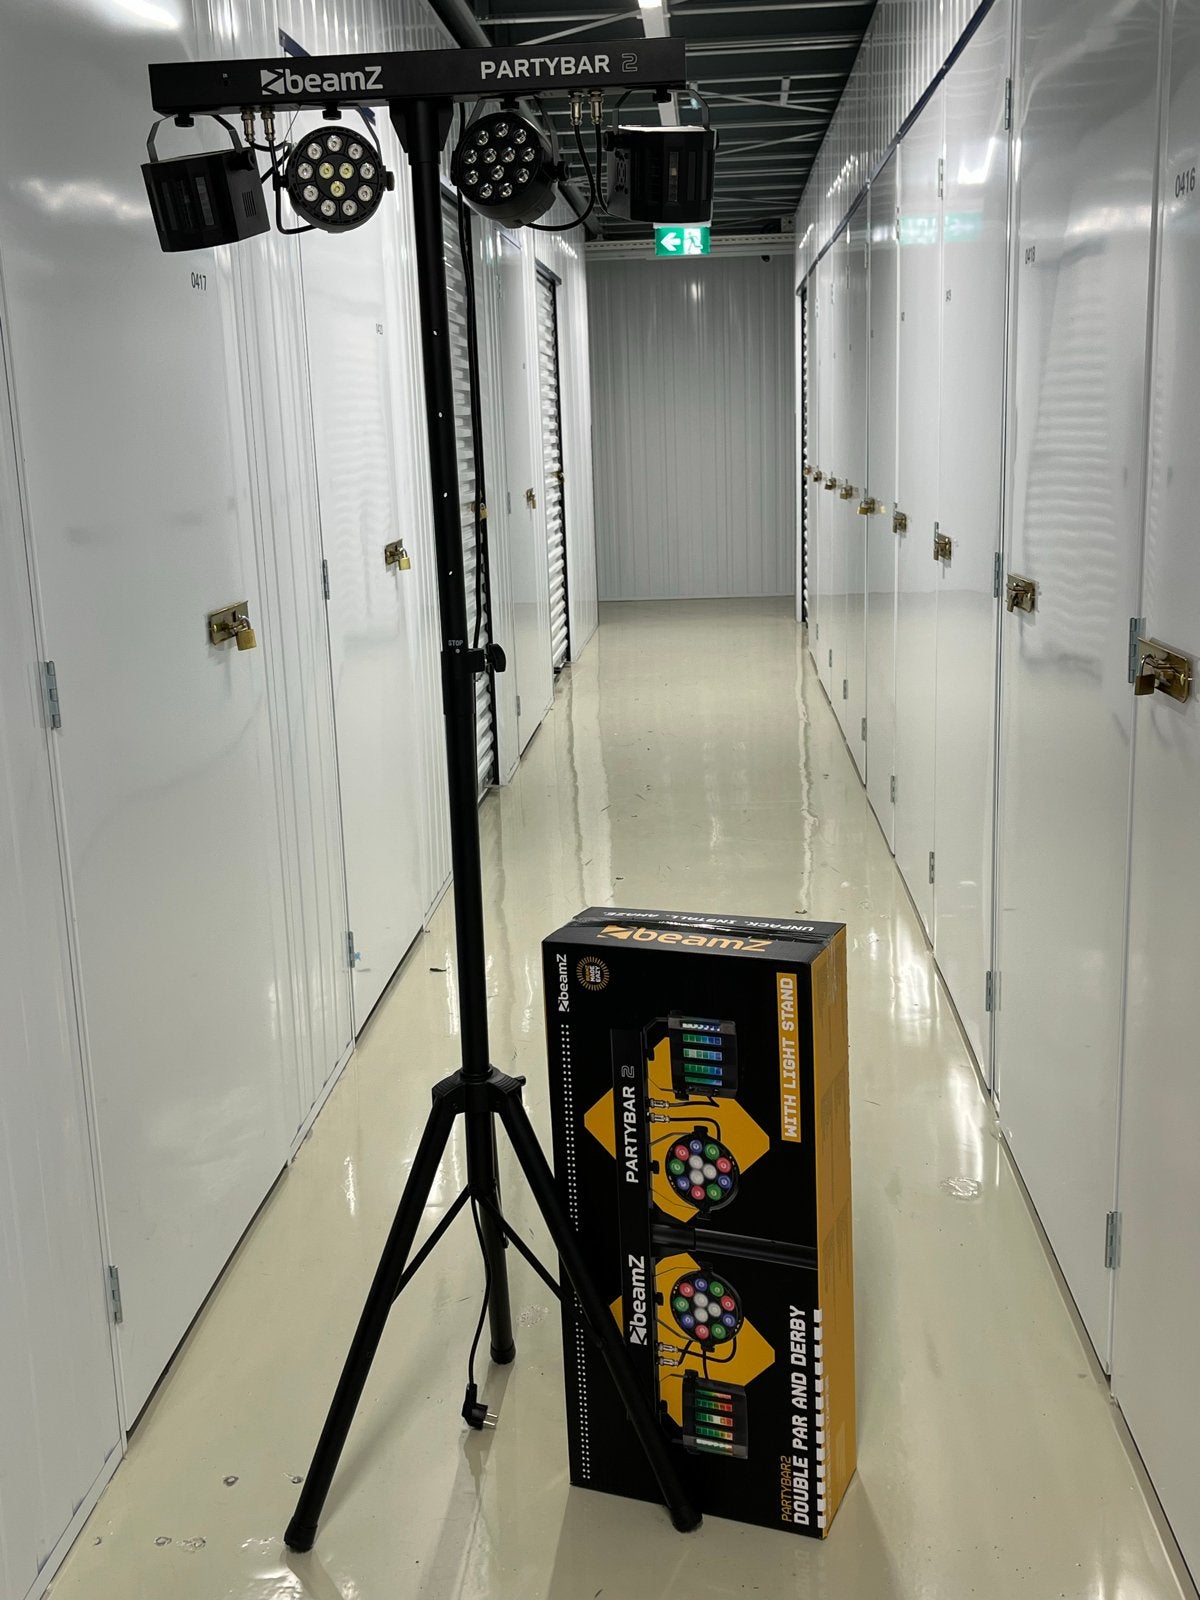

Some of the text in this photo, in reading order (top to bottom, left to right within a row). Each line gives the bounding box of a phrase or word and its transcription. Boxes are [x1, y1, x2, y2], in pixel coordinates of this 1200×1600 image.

[285, 66, 384, 94] beamZ
[481, 53, 638, 80] PARTYBAR 2
[1175, 167, 1196, 198] 0416
[191, 271, 206, 291] 0417
[666, 914, 738, 925] INSTALL.
[746, 920, 815, 932] UNPACK.
[632, 927, 773, 952] beamZ
[556, 953, 569, 1001] beamZ
[780, 977, 798, 1138] WITH LIGHT STAND
[621, 1065, 639, 1184] PARTYBAR 2
[629, 1254, 647, 1328] beamZ
[789, 1305, 810, 1526] DOUBLE PAR AND DERBY
[781, 1455, 793, 1522] PARTYBAR2
